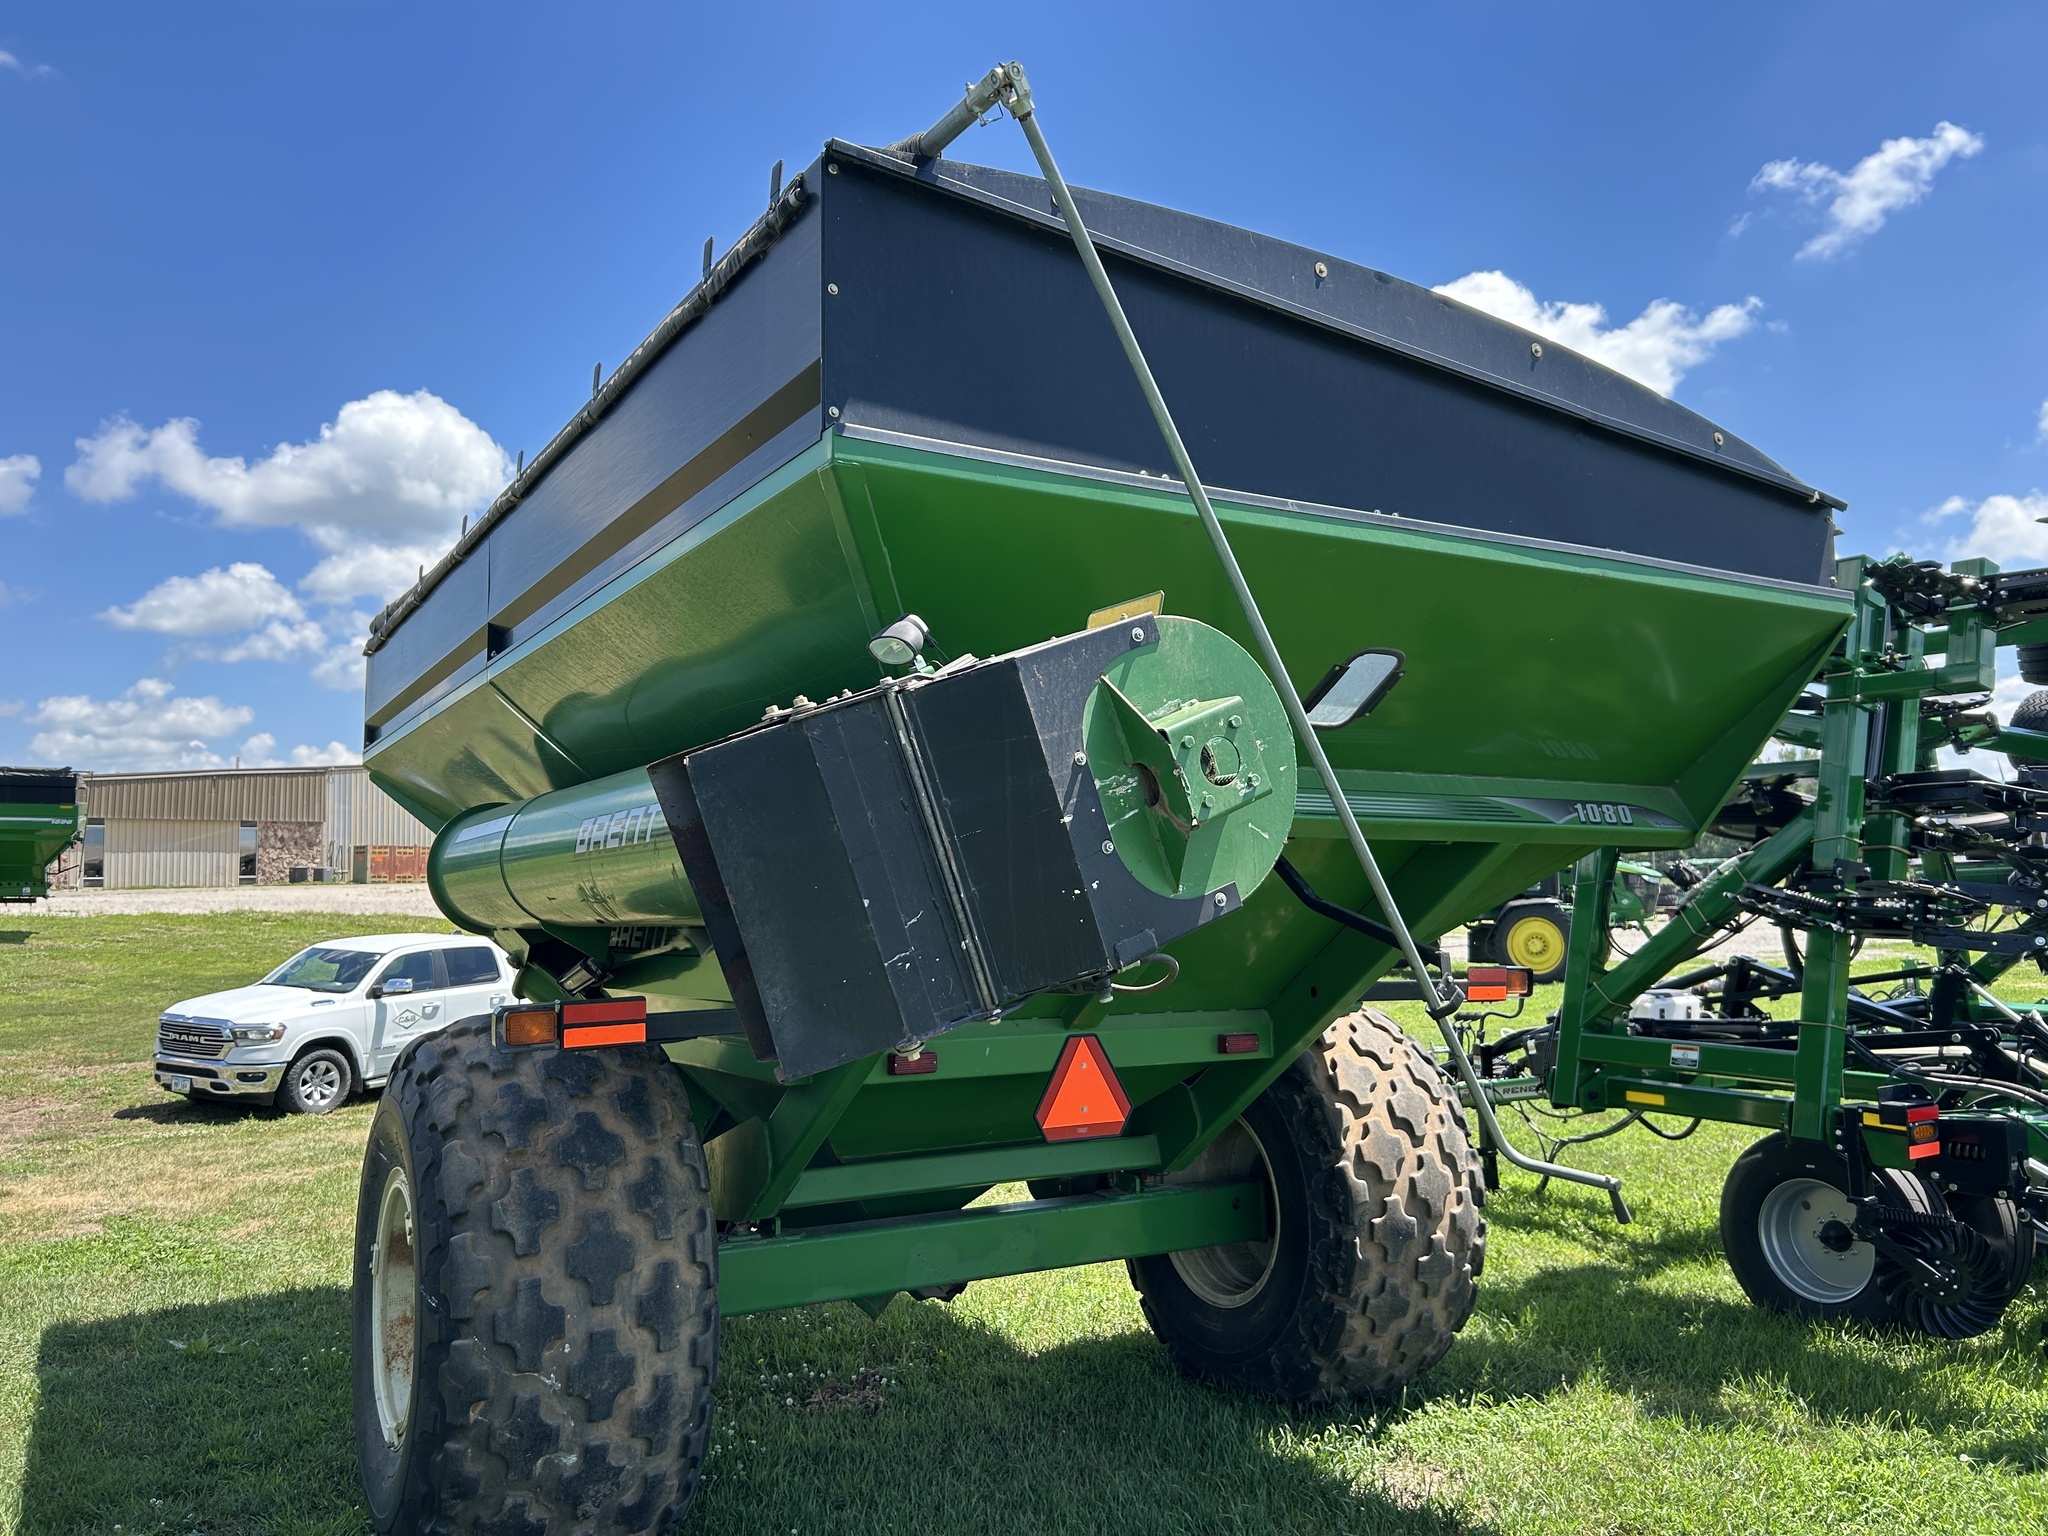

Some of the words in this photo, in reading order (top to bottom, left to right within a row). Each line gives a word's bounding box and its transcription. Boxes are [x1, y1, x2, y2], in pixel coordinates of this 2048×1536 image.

[1574, 803, 1633, 824] 1080
[575, 803, 662, 853] BRENT
[398, 1015, 416, 1023] C&B
[171, 1033, 199, 1042] RAM
[1503, 1085, 1538, 1095] RENE
